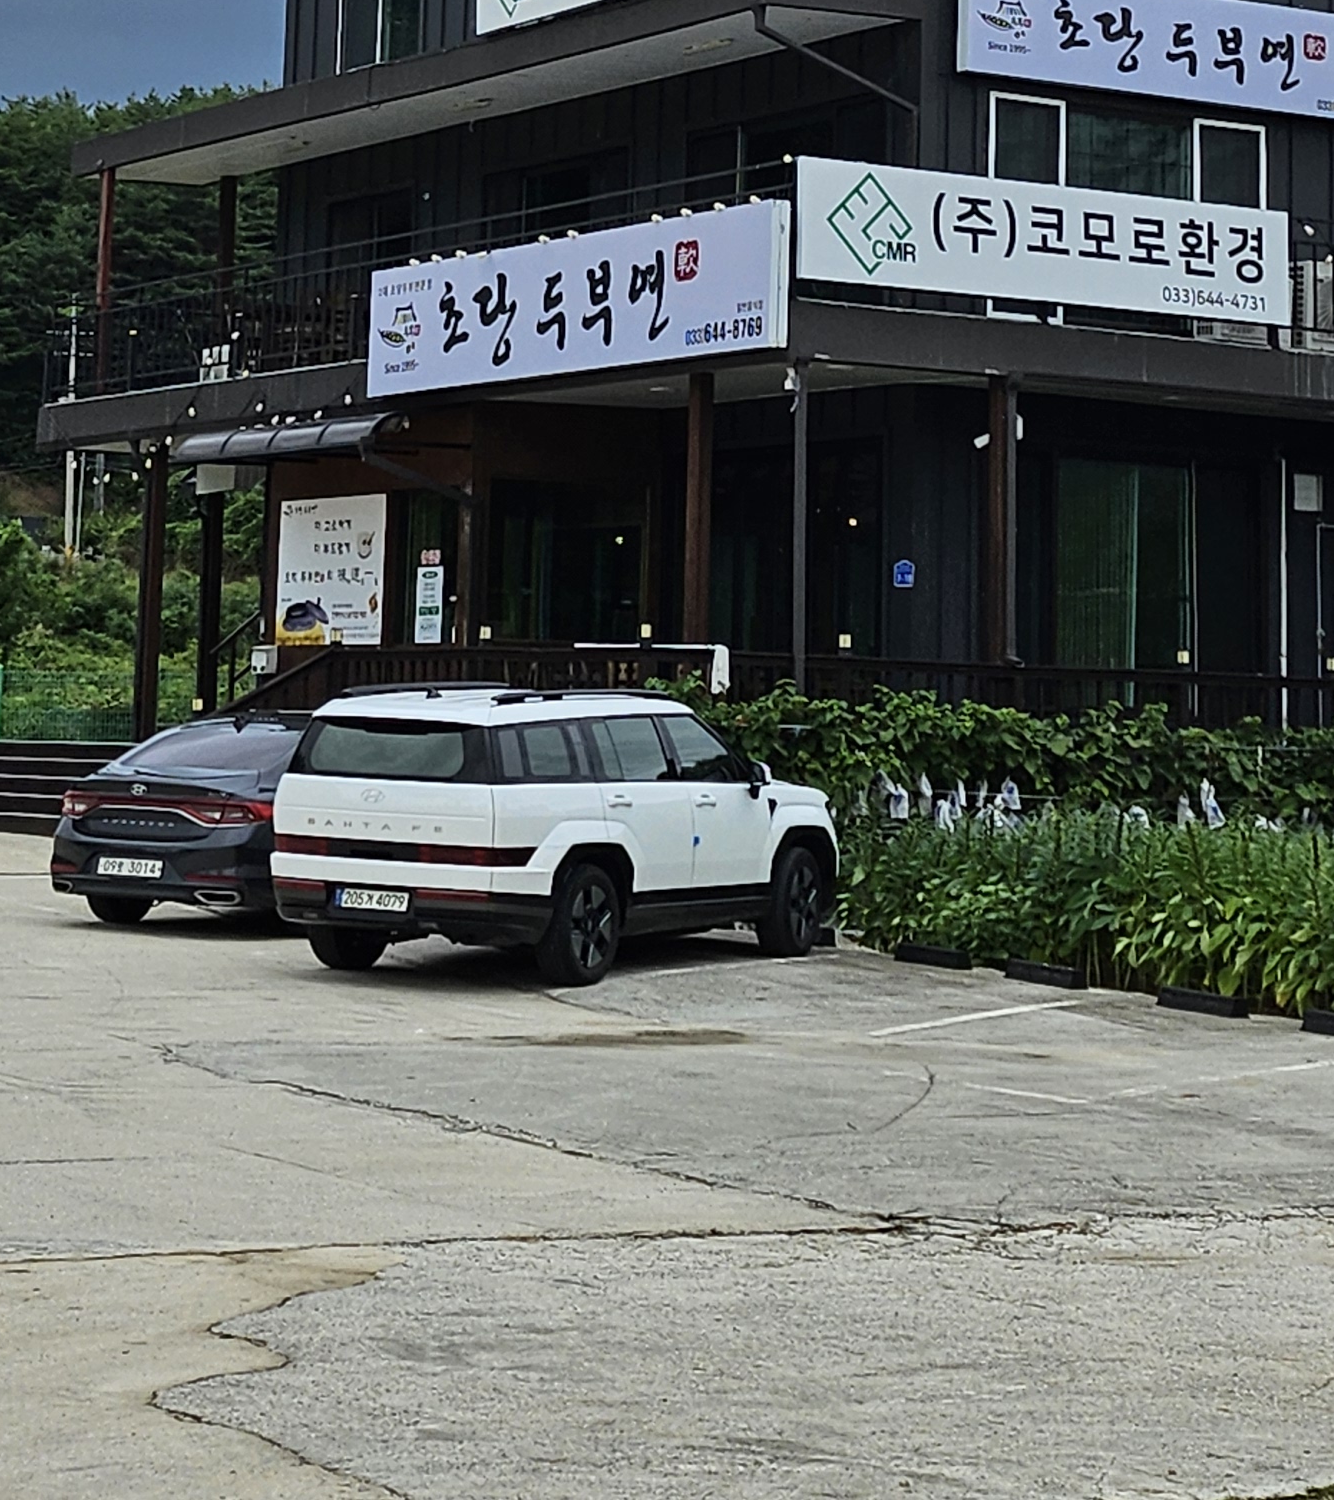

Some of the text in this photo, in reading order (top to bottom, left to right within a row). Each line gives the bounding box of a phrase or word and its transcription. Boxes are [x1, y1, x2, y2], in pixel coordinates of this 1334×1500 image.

[1166, 23, 1300, 92] 두부면
[932, 192, 1265, 284] (주)코모로환경
[872, 239, 917, 264] CMR
[438, 249, 671, 367] 초당 두부면
[1162, 286, 1266, 312] 033)644-4731
[128, 860, 156, 875] 3014
[376, 893, 406, 909] 4079
